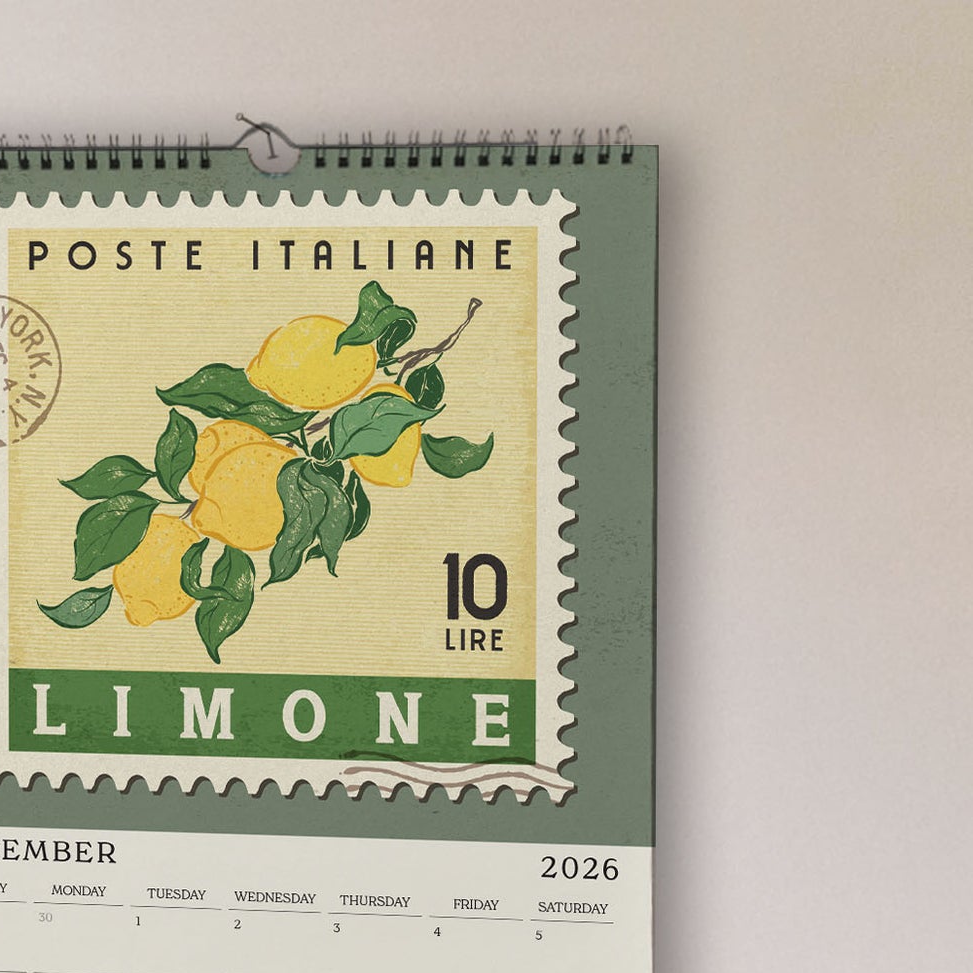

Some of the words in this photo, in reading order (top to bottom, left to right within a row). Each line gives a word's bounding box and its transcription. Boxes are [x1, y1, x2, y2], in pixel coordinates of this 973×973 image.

[28, 240, 202, 271] POSTE
[252, 239, 512, 270] ITALIANE
[442, 552, 508, 621] 10
[445, 628, 504, 652] LIRE
[33, 684, 511, 748] LIMONE
[540, 855, 620, 881] 2026
[50, 884, 107, 898] MONDAY
[146, 887, 207, 901] TUESDAY
[233, 890, 317, 905] WEDNESDAY
[338, 894, 411, 908] THURSDAY
[453, 898, 500, 911] FRIDAY
[537, 901, 609, 915] SATURDAY
[38, 911, 53, 922] 30
[135, 915, 141, 927] 1
[233, 918, 242, 930] 2
[332, 922, 341, 934] 3
[433, 926, 442, 937] 4
[535, 929, 543, 941] 5
